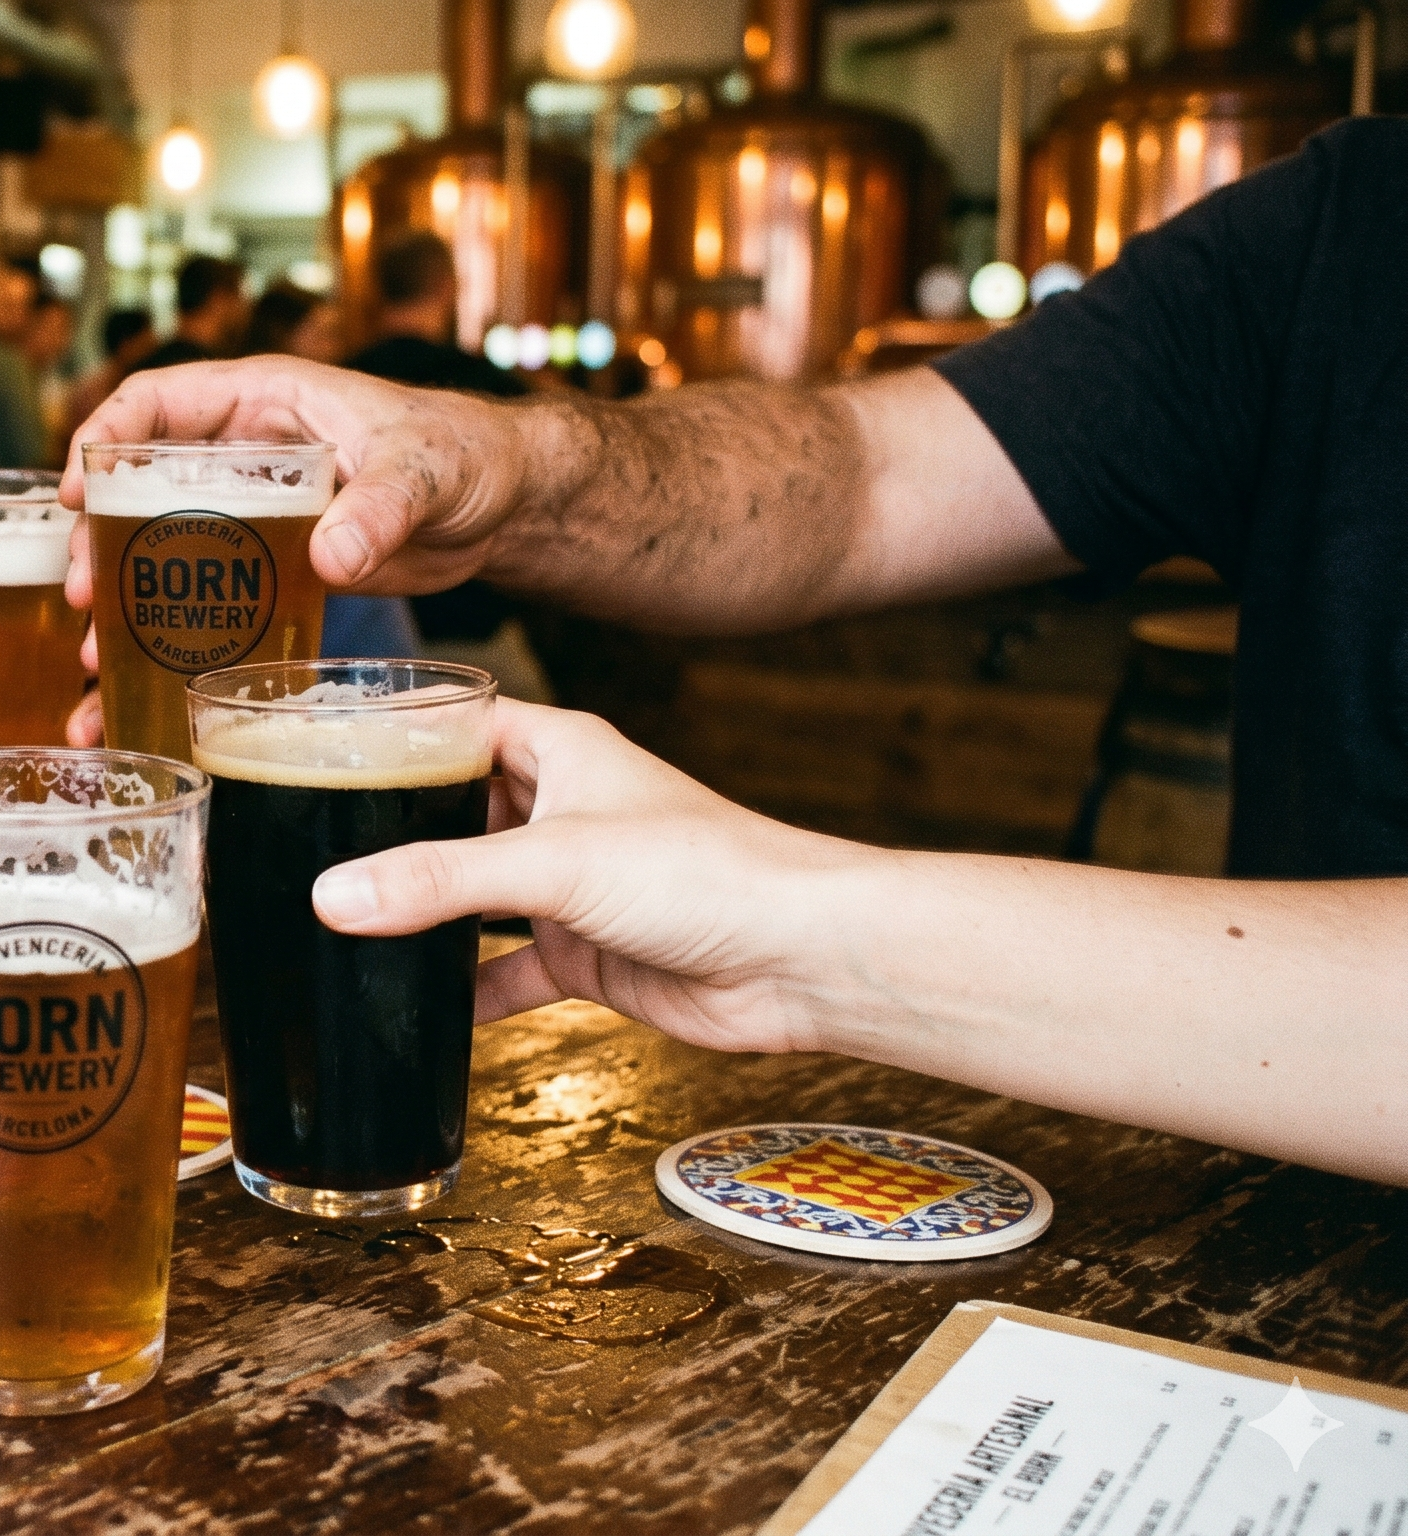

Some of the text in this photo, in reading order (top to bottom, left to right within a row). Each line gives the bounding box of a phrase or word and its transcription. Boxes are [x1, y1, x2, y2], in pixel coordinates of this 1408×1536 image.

[133, 556, 261, 601] BORN
[135, 603, 259, 629] BREWERY
[152, 636, 240, 665] BARCELONA
[963, 1395, 1054, 1475] ARTESANAL
[1001, 1449, 1063, 1503] EL BORN
